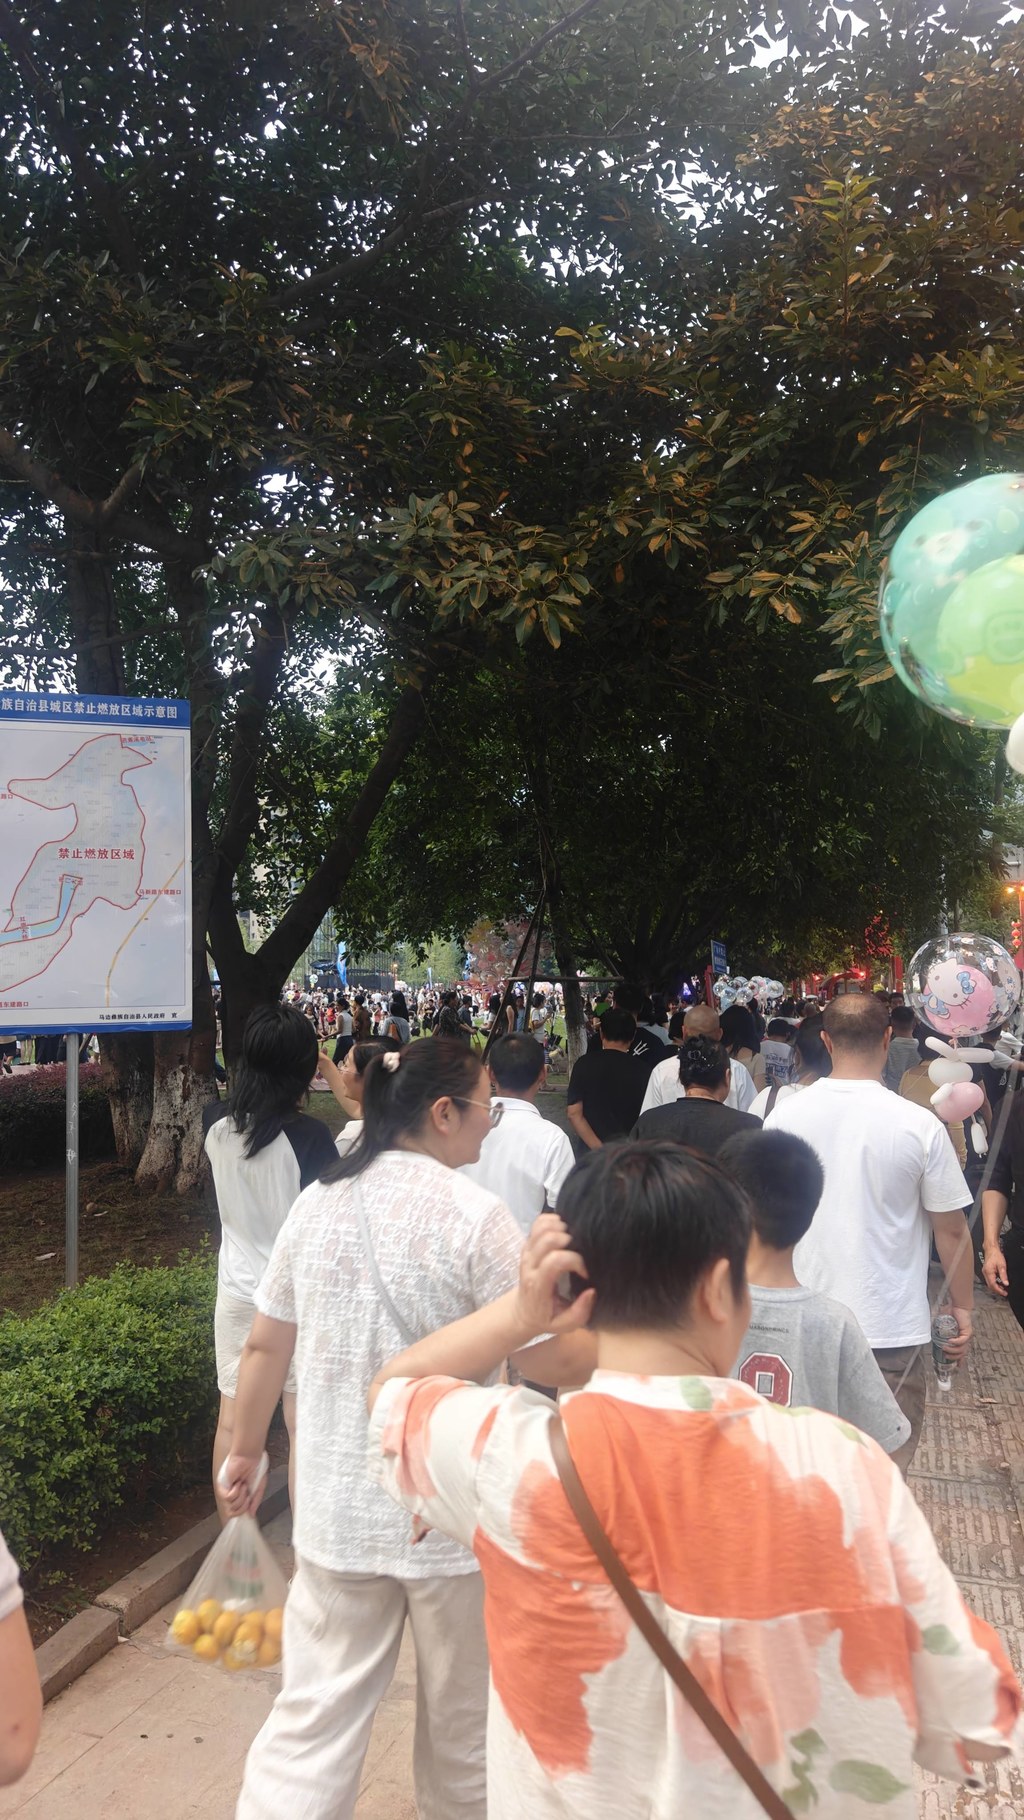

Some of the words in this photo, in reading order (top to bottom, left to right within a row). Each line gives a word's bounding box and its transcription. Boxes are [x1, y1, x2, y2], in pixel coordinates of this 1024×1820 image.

[1, 697, 178, 719] 族自治县城区禁止燃放区域示意图
[58, 847, 135, 860] 禁止燃放区域
